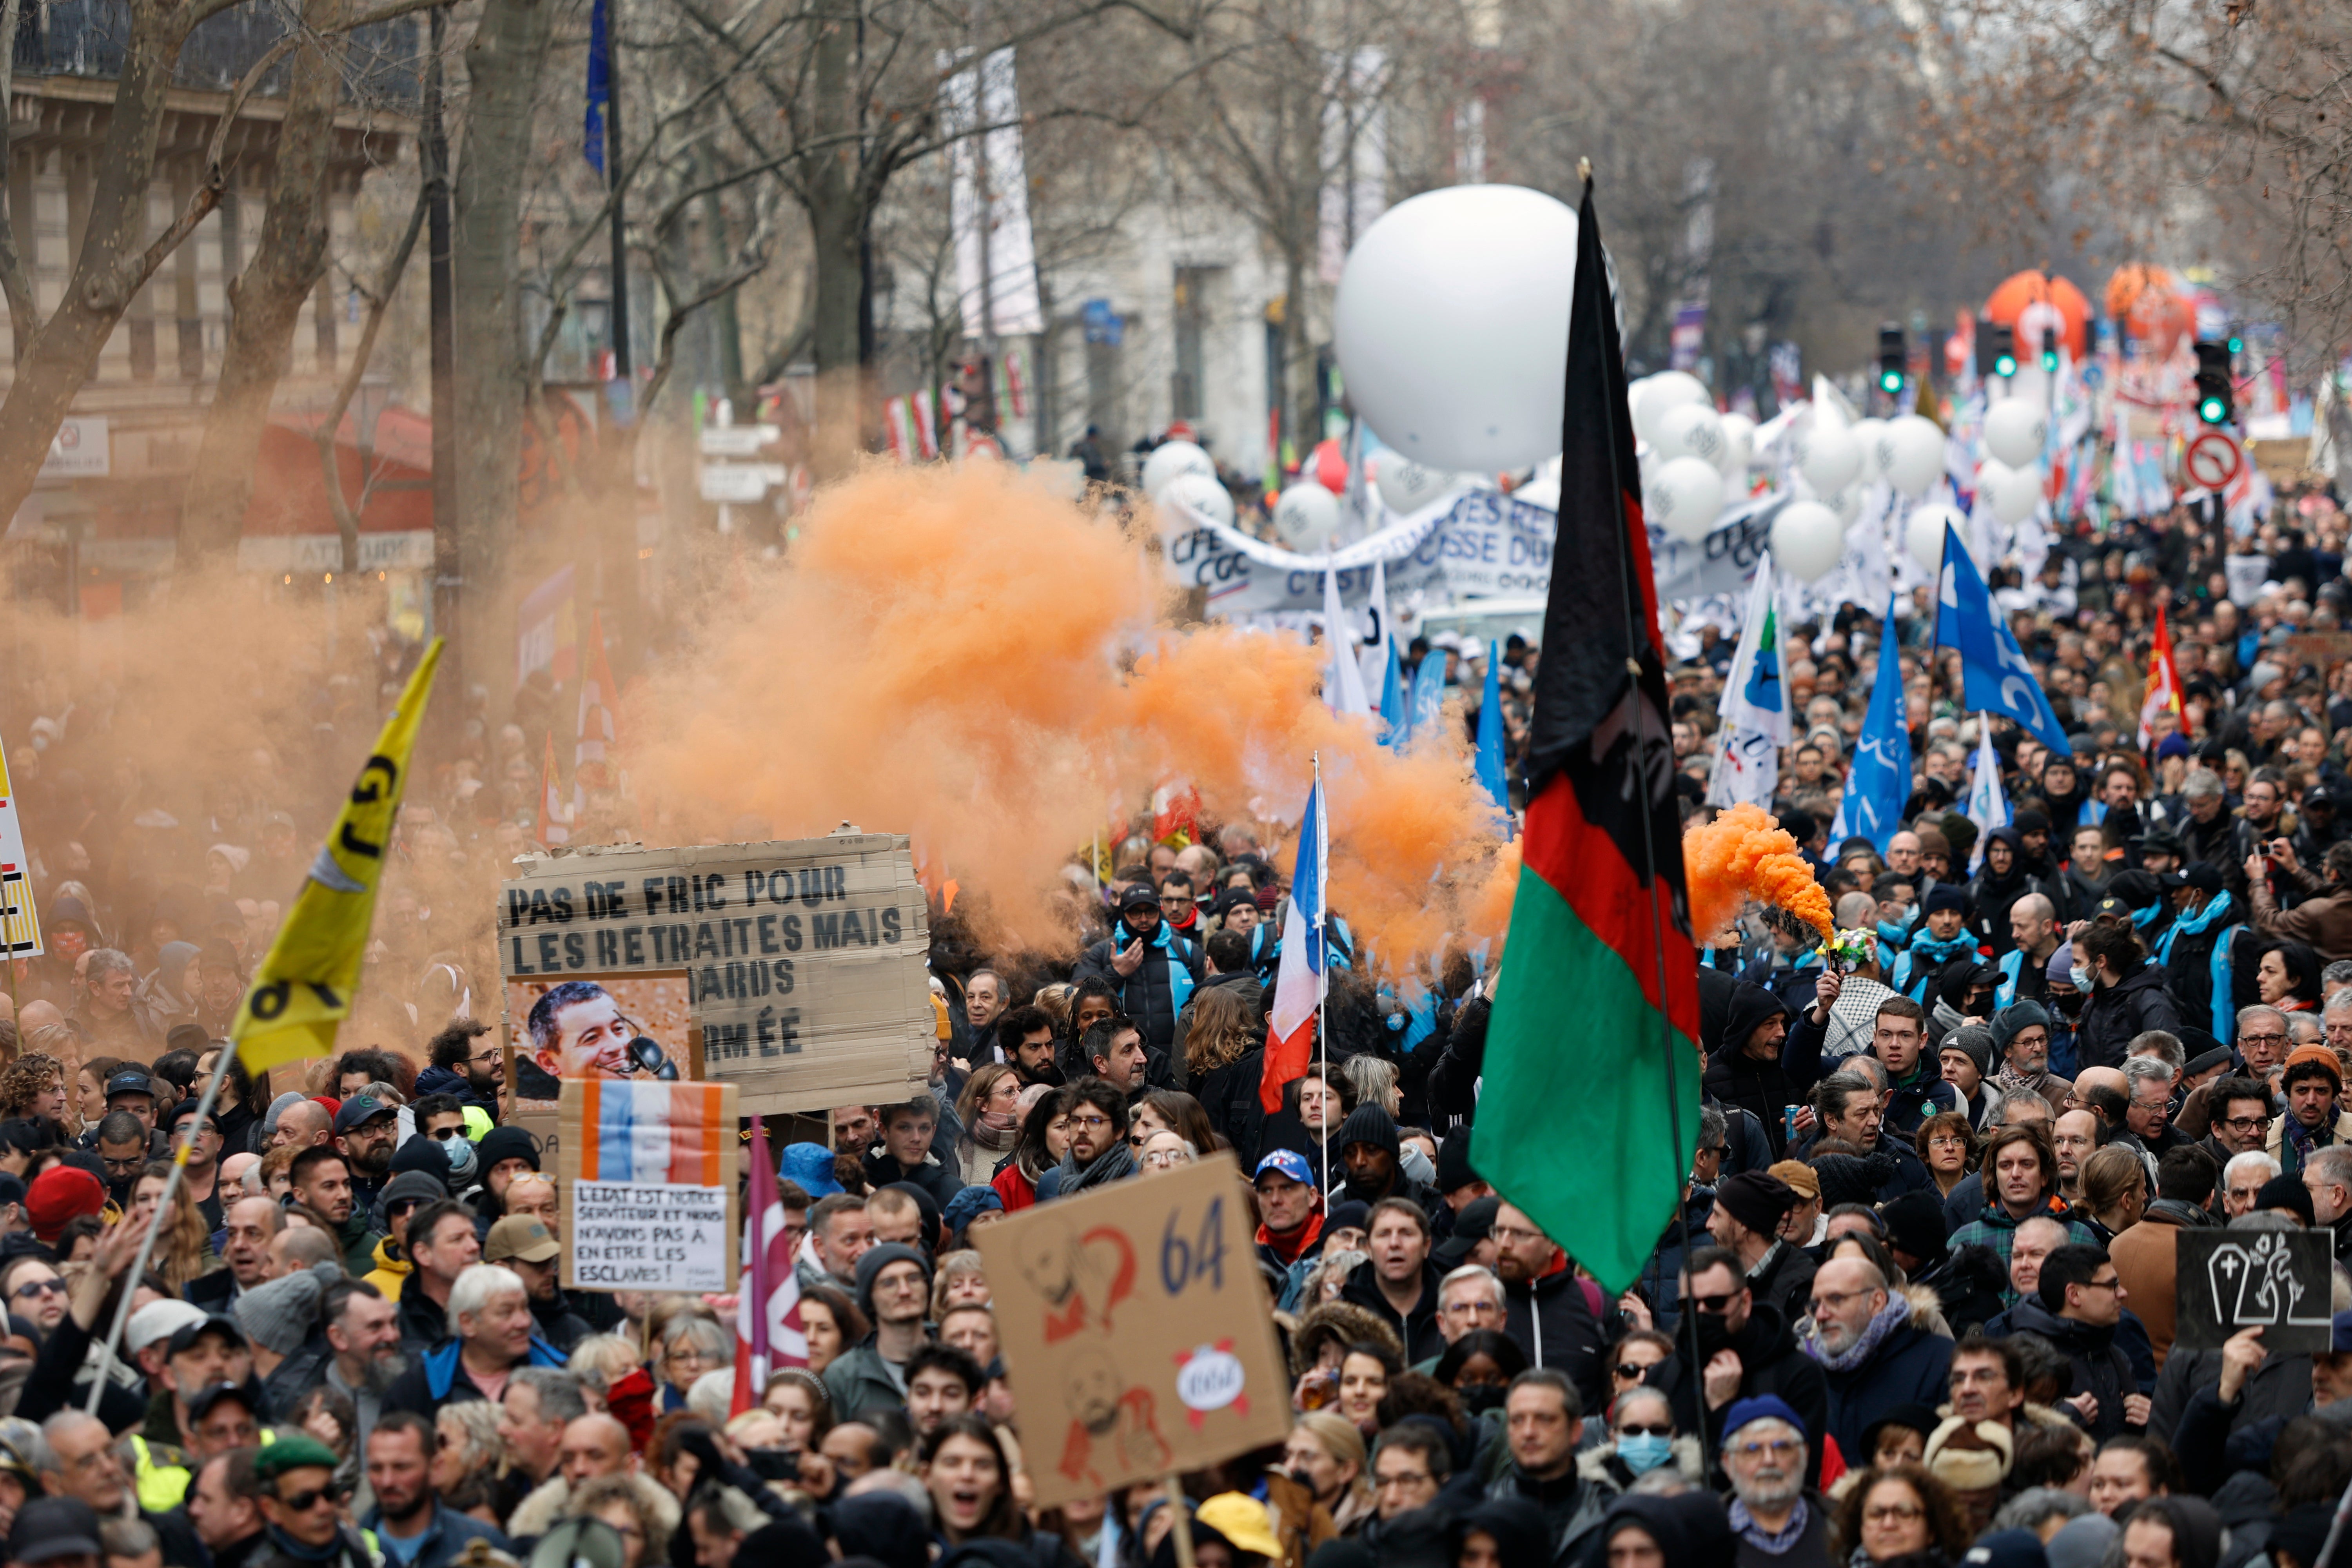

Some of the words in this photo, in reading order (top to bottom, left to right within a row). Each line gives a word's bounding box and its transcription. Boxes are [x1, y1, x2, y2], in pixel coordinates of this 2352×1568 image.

[508, 887, 573, 927] PAS
[584, 880, 628, 920] DE
[643, 873, 726, 916] FRIC
[745, 866, 845, 908] POUR
[513, 932, 586, 975] LES
[596, 914, 802, 967] RETRAITES
[811, 907, 901, 949] MAIS
[703, 1005, 802, 1062] RMÉE
[635, 1190, 664, 1204] EST
[668, 1191, 715, 1205] NOTRE
[664, 1210, 682, 1222] ET
[653, 1227, 684, 1244] PAS
[578, 1246, 599, 1260] EN
[655, 1247, 686, 1261] LES
[1159, 1193, 1233, 1297] 64
[579, 1265, 661, 1283] ESCLAVES
